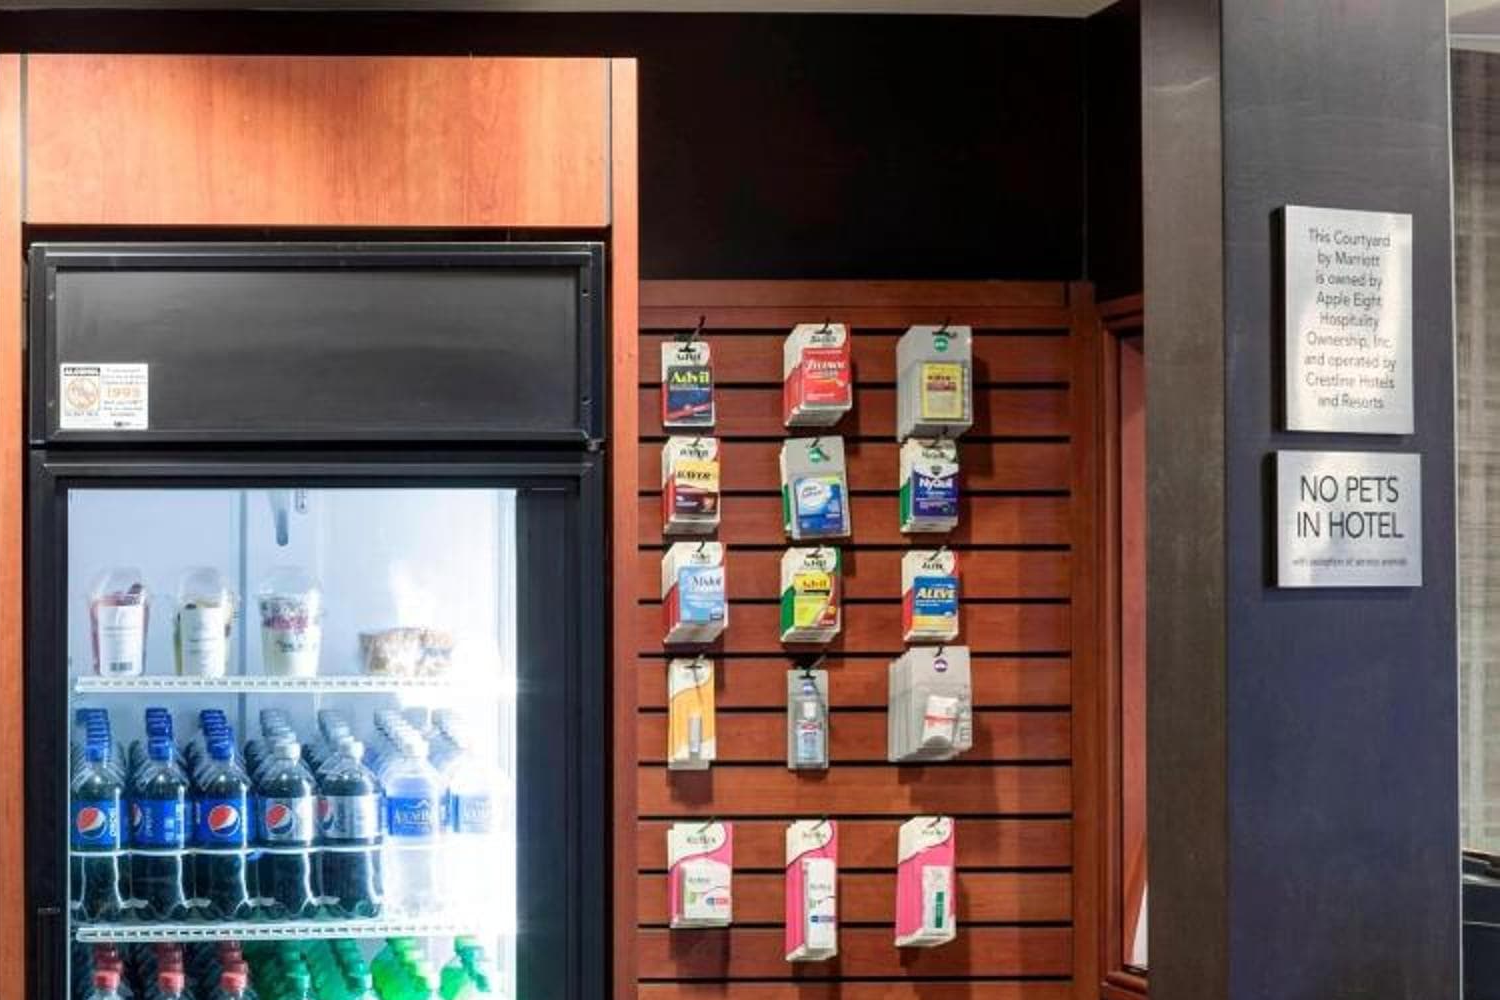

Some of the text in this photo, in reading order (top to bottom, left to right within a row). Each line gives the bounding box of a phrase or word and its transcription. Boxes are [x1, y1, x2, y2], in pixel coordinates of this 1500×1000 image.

[1308, 227, 1391, 249] This Courtyard
[1317, 250, 1380, 268] by Marriott
[1327, 272, 1366, 287] owned
[1369, 271, 1383, 291] by
[1316, 290, 1382, 311] Apple Eight
[1320, 312, 1380, 332] Hospitality
[1304, 352, 1396, 373] and operated by
[1359, 373, 1395, 389] Hotels
[1318, 393, 1384, 409] and Resorts
[1300, 475, 1399, 503] NO PETS
[1297, 511, 1405, 539] IN HOTEL
